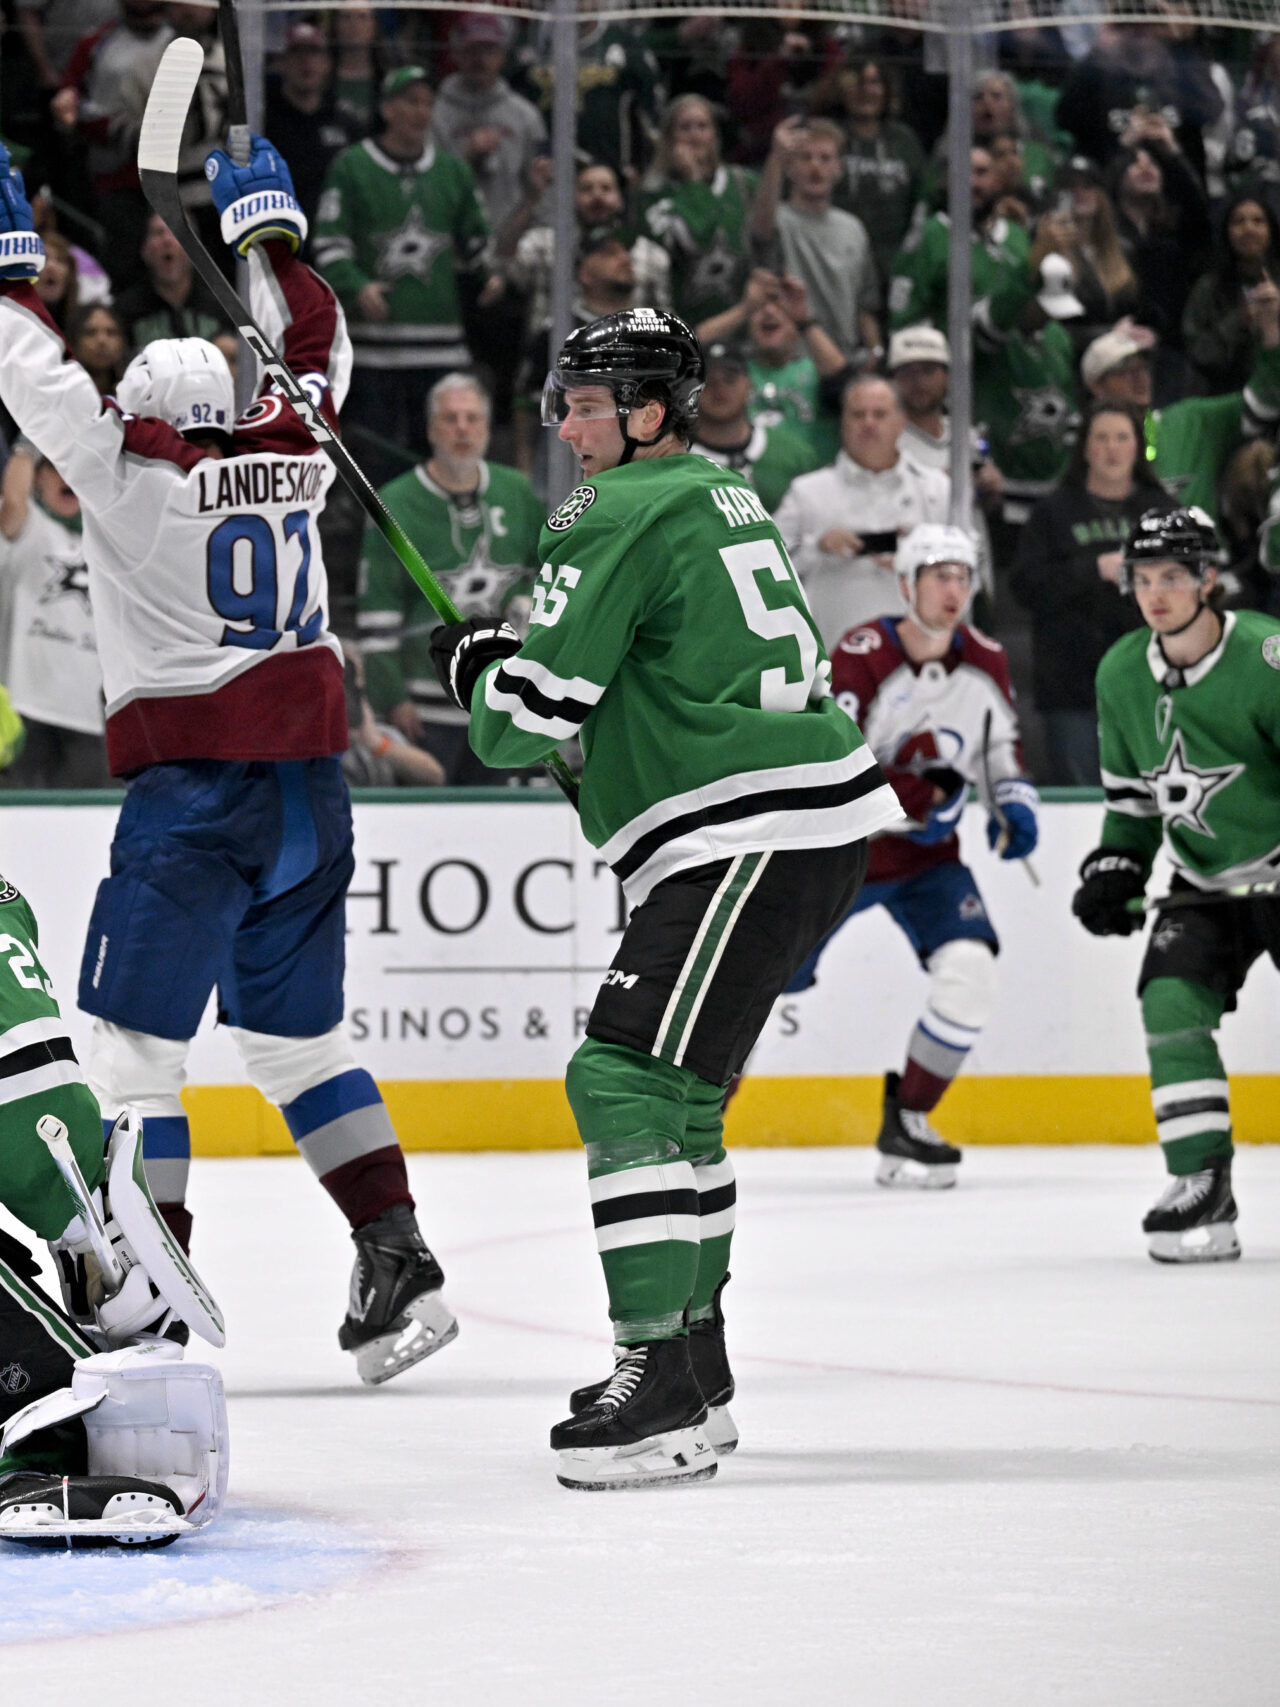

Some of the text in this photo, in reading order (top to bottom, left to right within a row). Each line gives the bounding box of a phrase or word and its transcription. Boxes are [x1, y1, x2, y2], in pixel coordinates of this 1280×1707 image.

[626, 324, 671, 333] TRANSFER
[239, 325, 332, 442] CCM
[191, 403, 212, 424] 92
[490, 506, 507, 537] C
[524, 1008, 548, 1039] &
[9, 1370, 20, 1391] NHL
